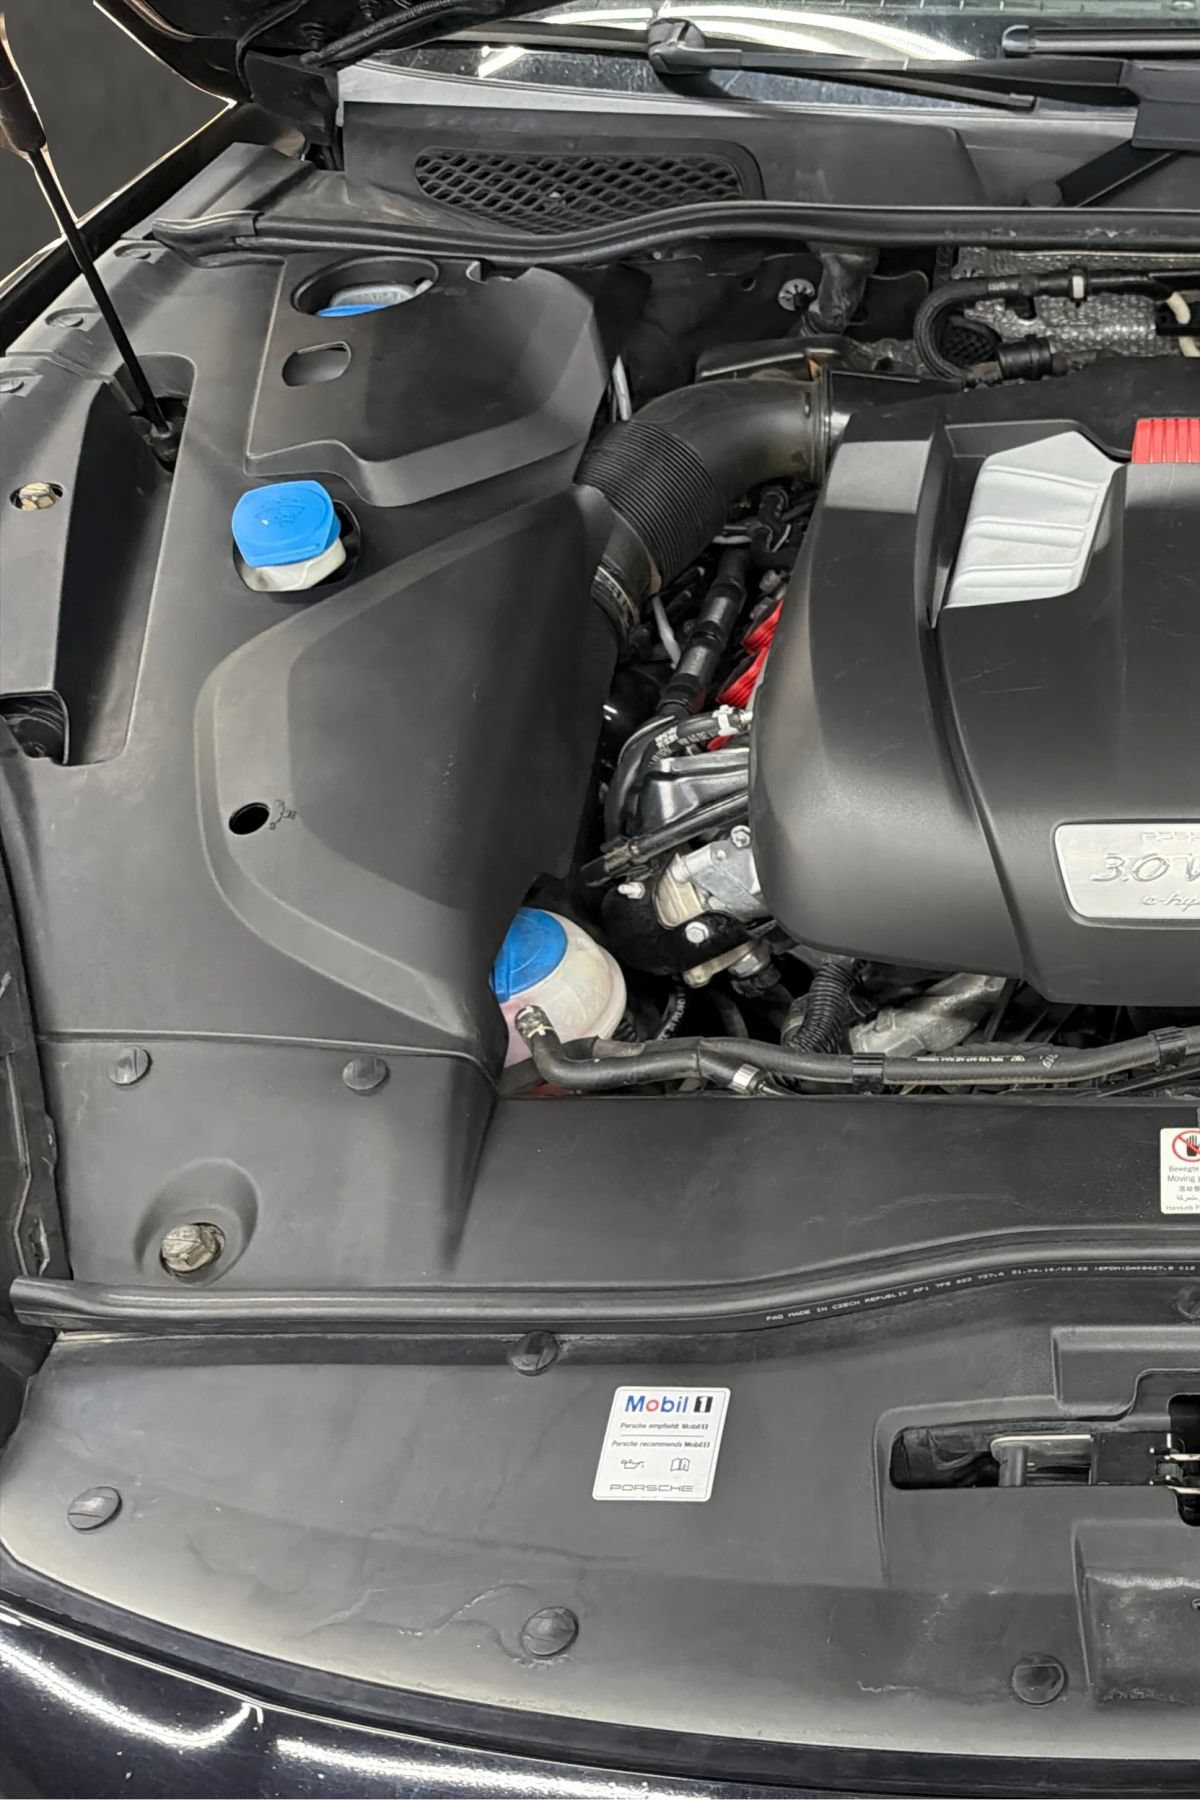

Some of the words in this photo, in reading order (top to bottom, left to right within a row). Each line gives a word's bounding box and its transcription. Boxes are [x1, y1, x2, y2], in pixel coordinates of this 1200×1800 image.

[1091, 852, 1170, 883] 3.0
[1168, 1165, 1199, 1173] Bewegte
[1167, 1175, 1196, 1183] Moving
[788, 1309, 811, 1318] MADE
[831, 1300, 861, 1311] CZECH
[625, 1395, 689, 1413] Mobil
[693, 1396, 713, 1413] 1
[620, 1422, 647, 1430] Porsche
[611, 1440, 639, 1448] Porsche
[639, 1440, 683, 1448] recommends
[609, 1483, 695, 1493] PORSCHE
